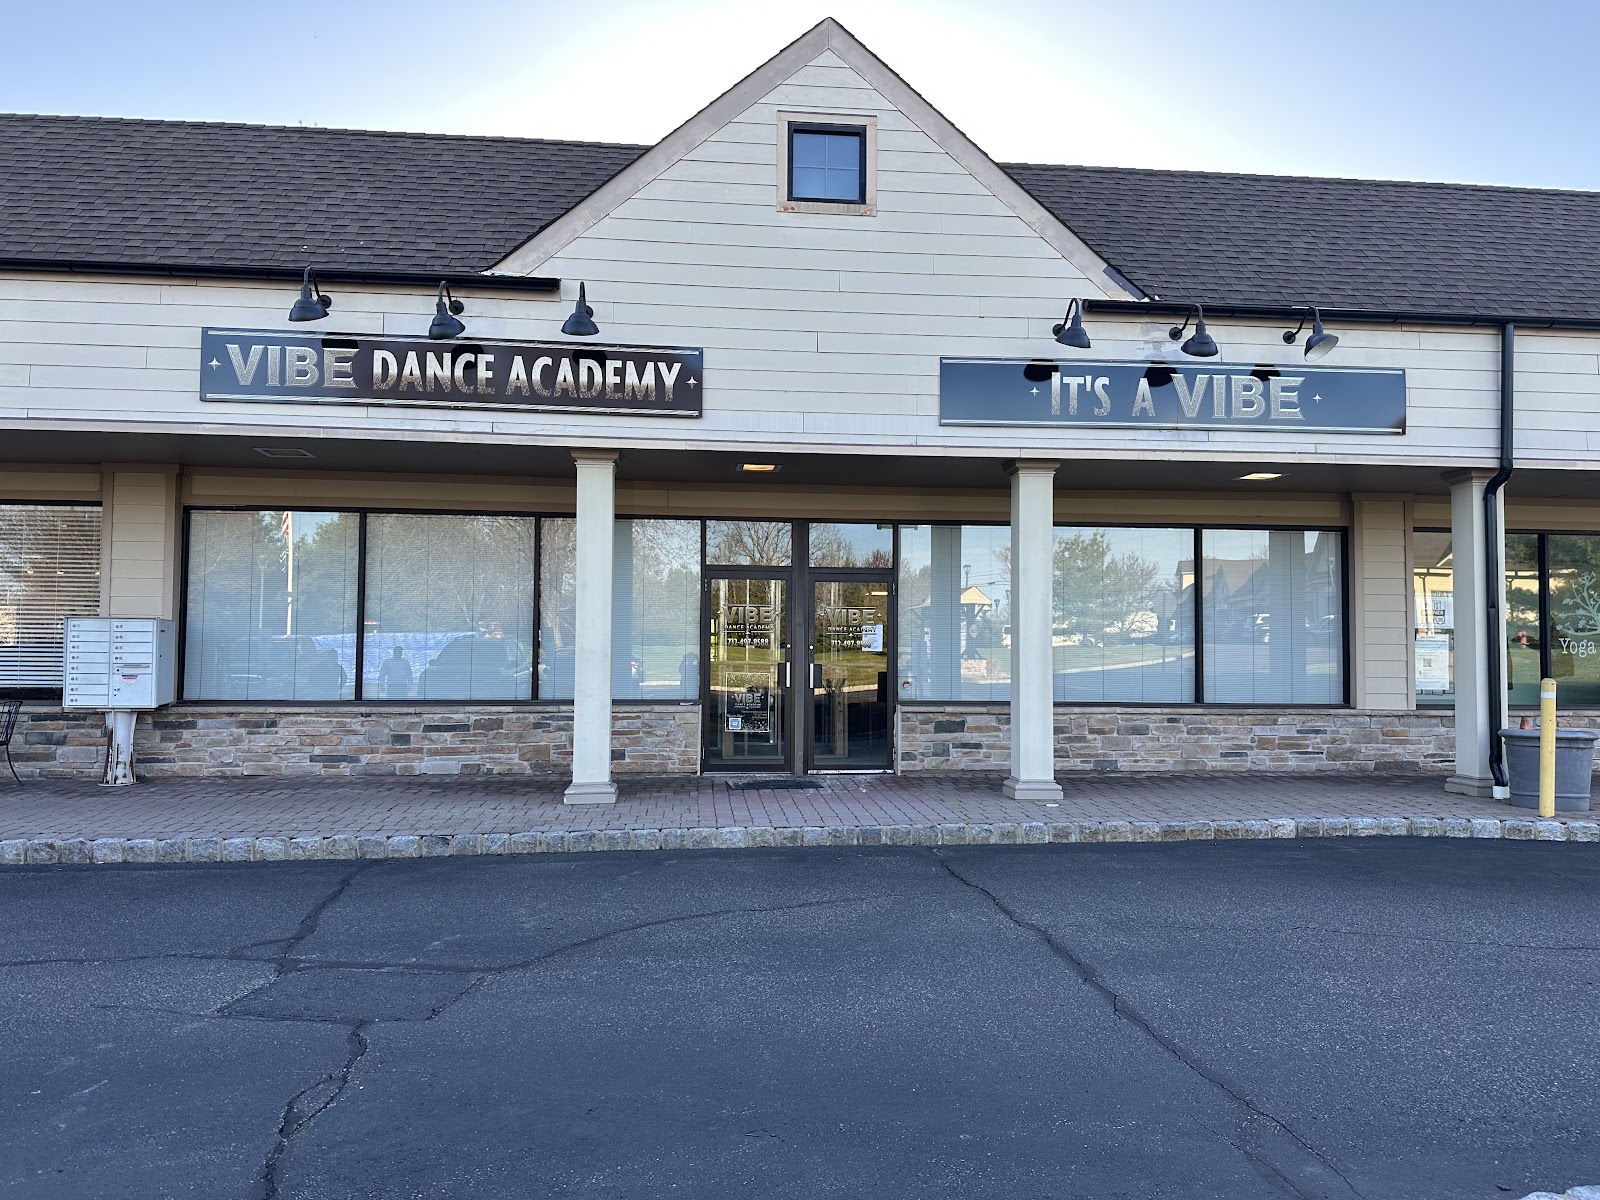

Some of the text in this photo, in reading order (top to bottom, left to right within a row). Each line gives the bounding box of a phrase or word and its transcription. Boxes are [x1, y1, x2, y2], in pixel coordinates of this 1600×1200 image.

[225, 343, 682, 402] VIBE DANCE ACADEMY
[1050, 372, 1306, 421] IT'S A VIBE
[723, 606, 774, 624] VIBE
[826, 608, 877, 626] VIBE
[1558, 637, 1597, 658] Yoga
[734, 693, 762, 703] VIBE
